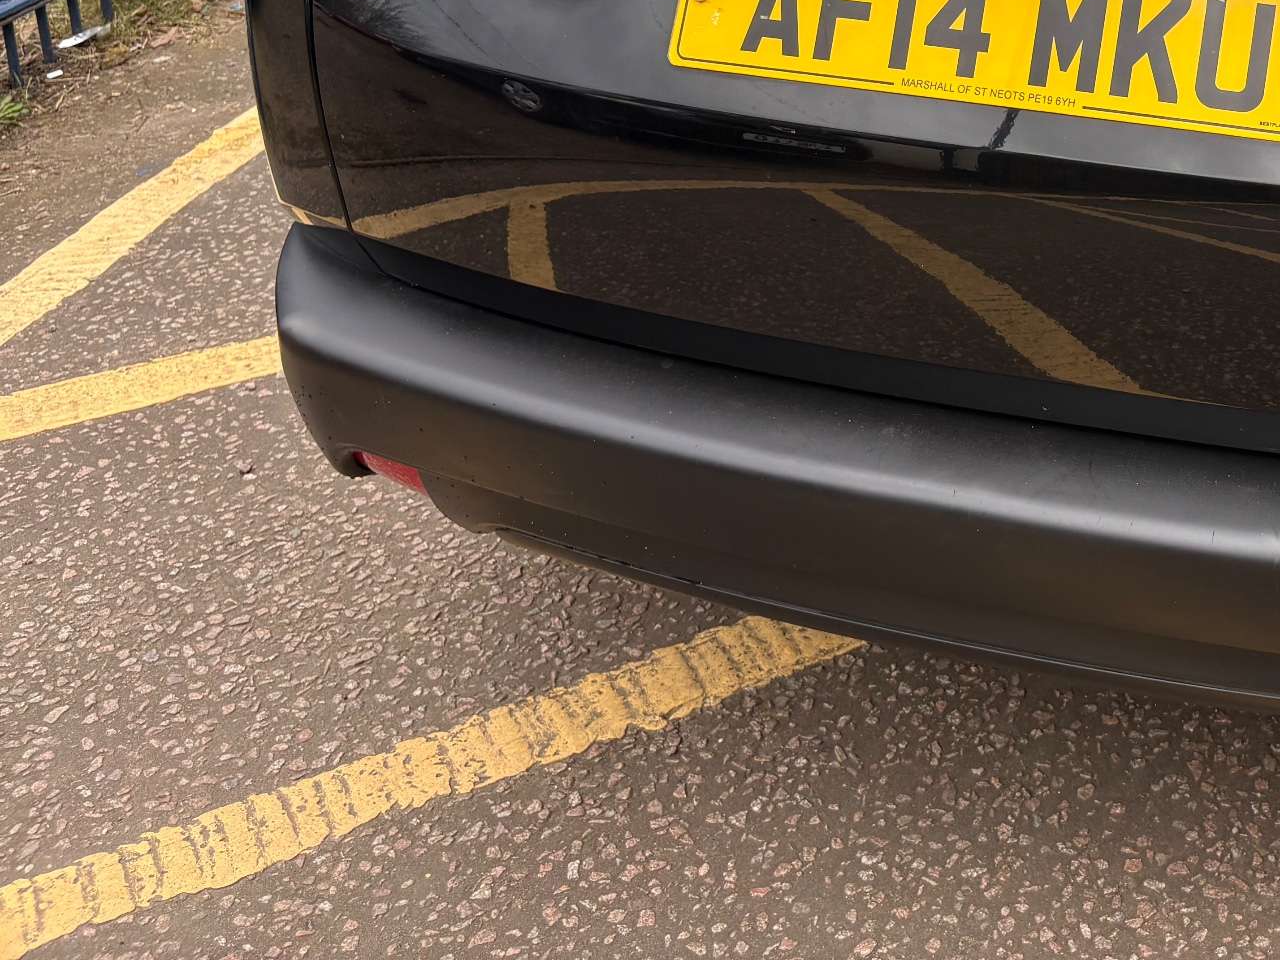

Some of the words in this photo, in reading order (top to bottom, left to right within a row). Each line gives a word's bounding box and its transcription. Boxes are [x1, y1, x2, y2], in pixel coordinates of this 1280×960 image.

[901, 77, 955, 93] MARSHALL
[957, 84, 971, 94] OF
[974, 87, 987, 97] ST
[990, 89, 1025, 102] NEOTS
[1028, 93, 1052, 105] PE19
[1055, 96, 1076, 108] 6YH
